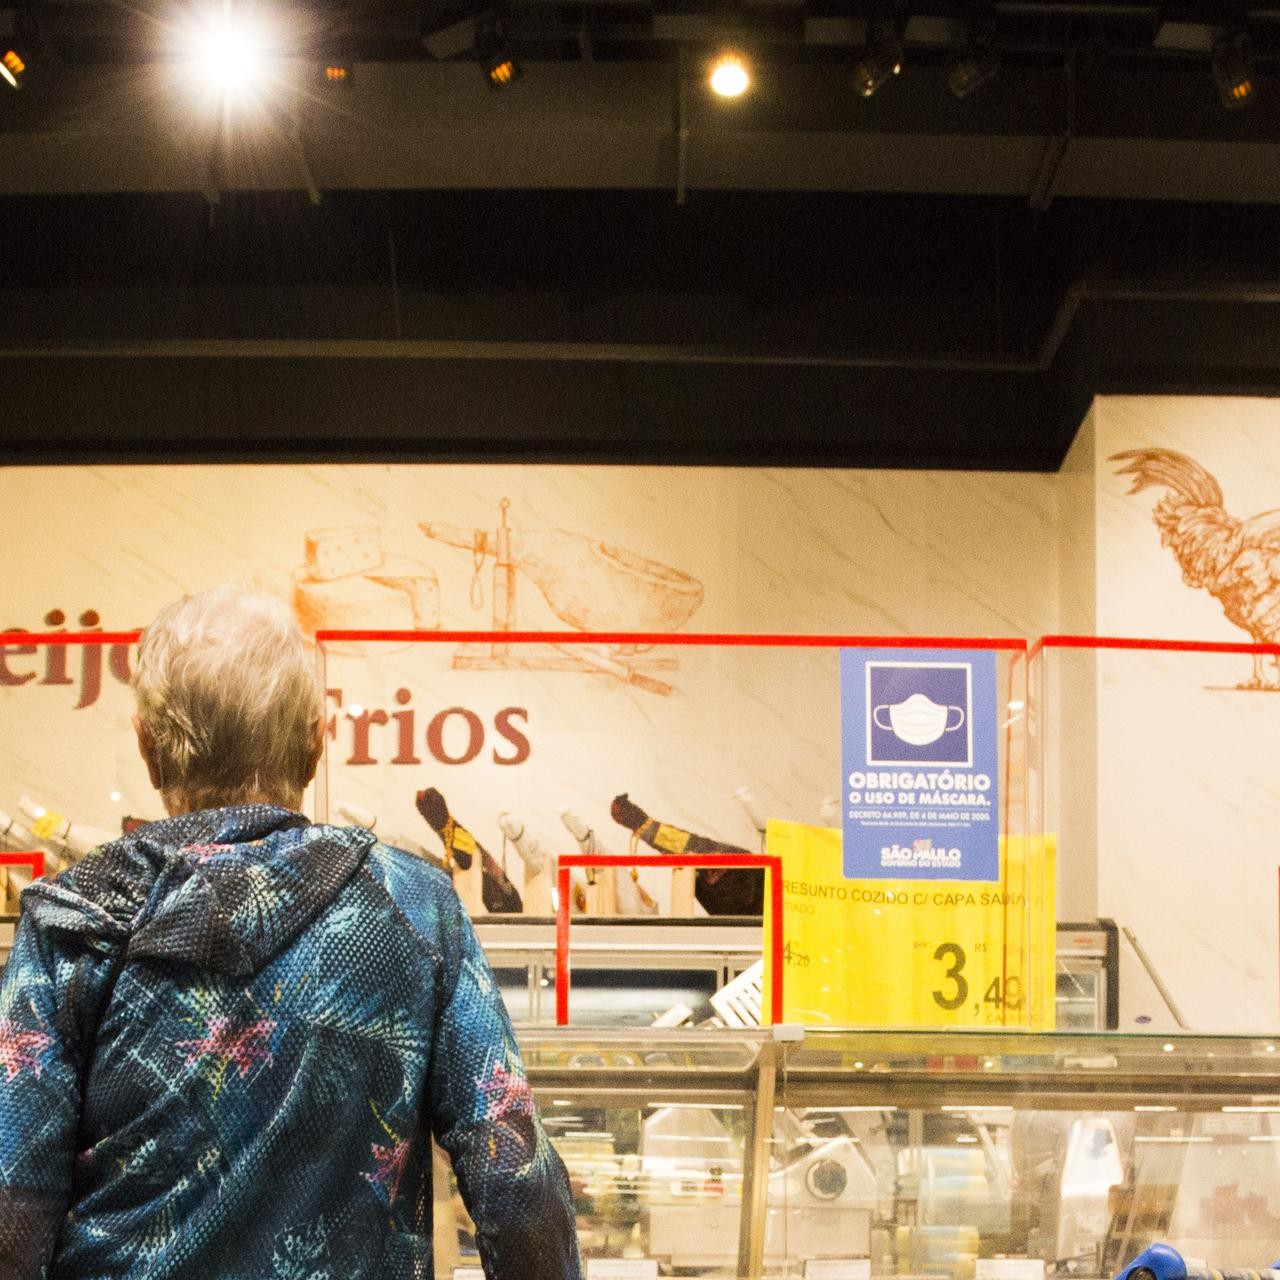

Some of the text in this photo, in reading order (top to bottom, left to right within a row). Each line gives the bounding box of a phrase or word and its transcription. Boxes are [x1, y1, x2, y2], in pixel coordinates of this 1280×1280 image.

[324, 687, 532, 767] Frios
[848, 768, 991, 791] OBRIGATÓRIO
[848, 789, 991, 806] O USO DE MÁSCARA.
[938, 811, 959, 821] MAIO
[880, 844, 961, 861] SÃO PAULO
[782, 880, 847, 901] RESUNTO
[851, 889, 909, 906] COZIDO
[932, 890, 976, 908] CAPA
